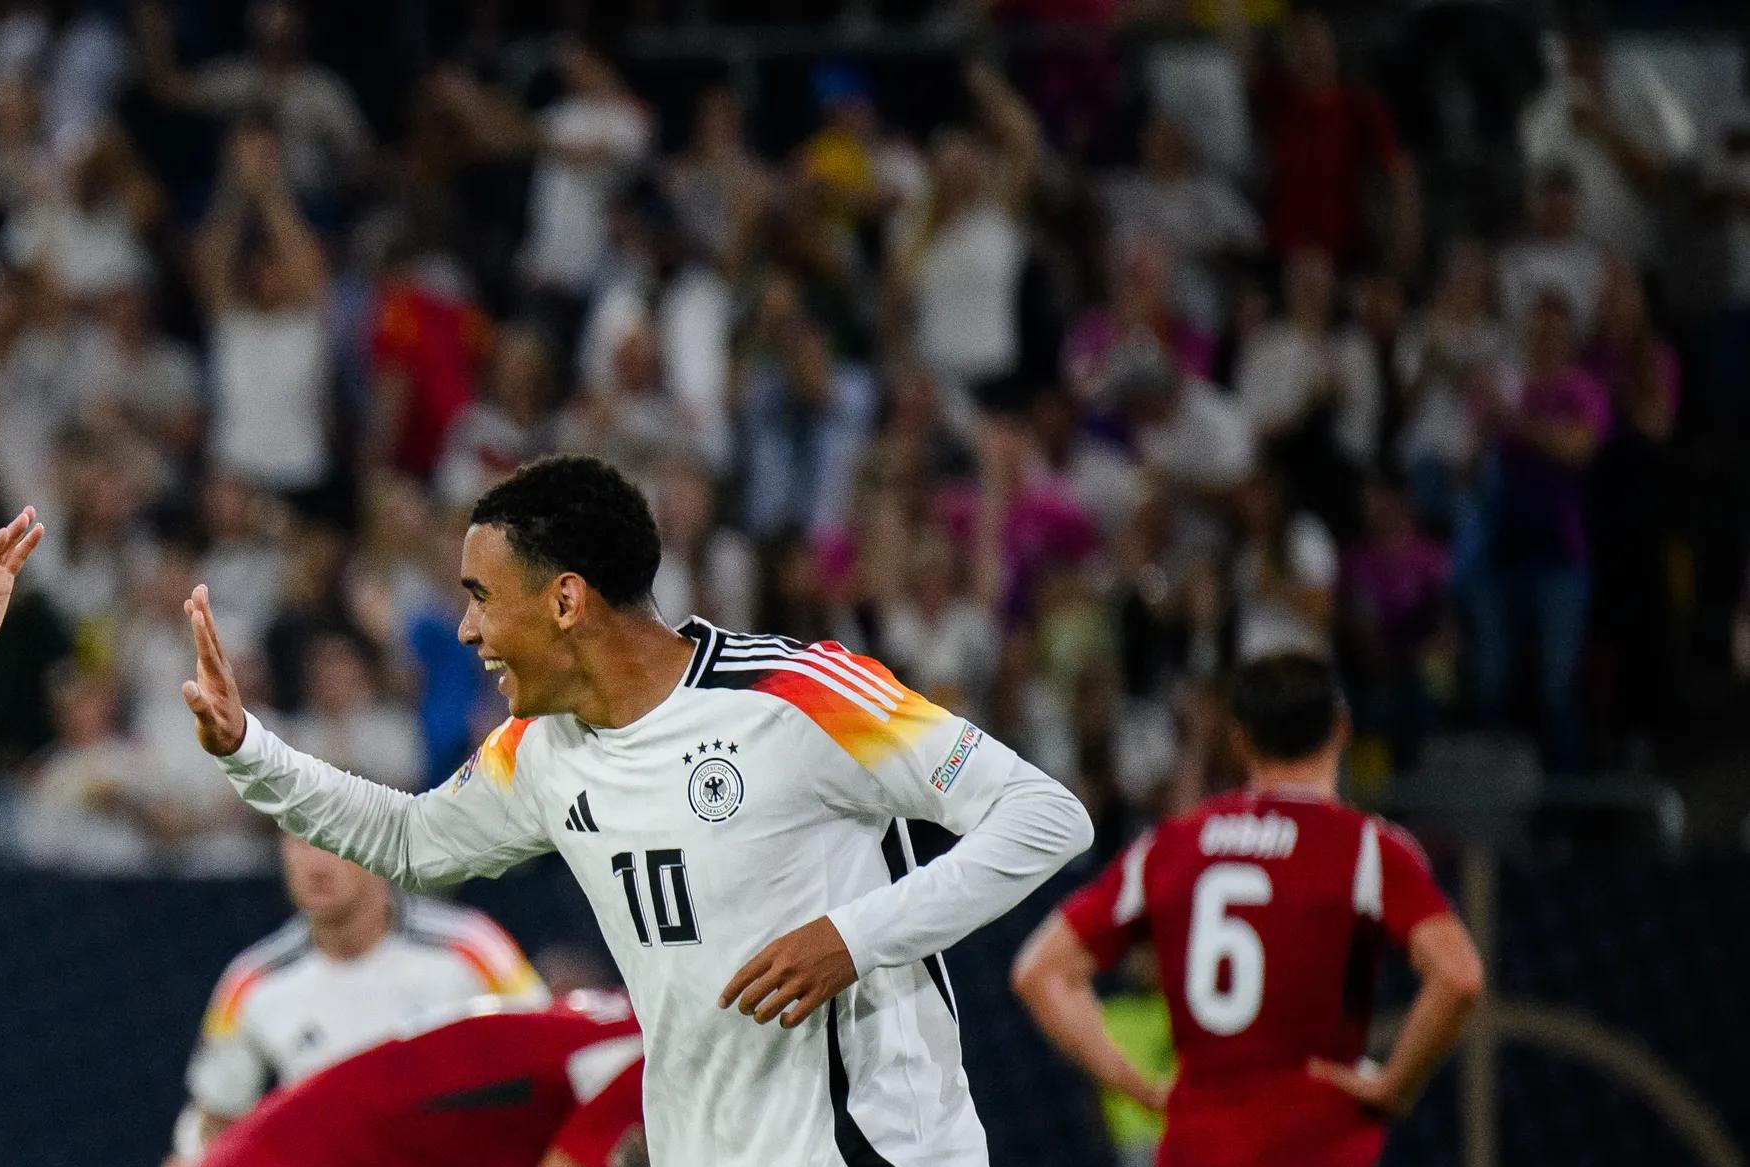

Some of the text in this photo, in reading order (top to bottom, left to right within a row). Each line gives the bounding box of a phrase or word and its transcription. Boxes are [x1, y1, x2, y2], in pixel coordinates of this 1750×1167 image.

[935, 724, 977, 792] FOUNDATION
[611, 848, 702, 947] 10
[1186, 861, 1273, 1036] 6
